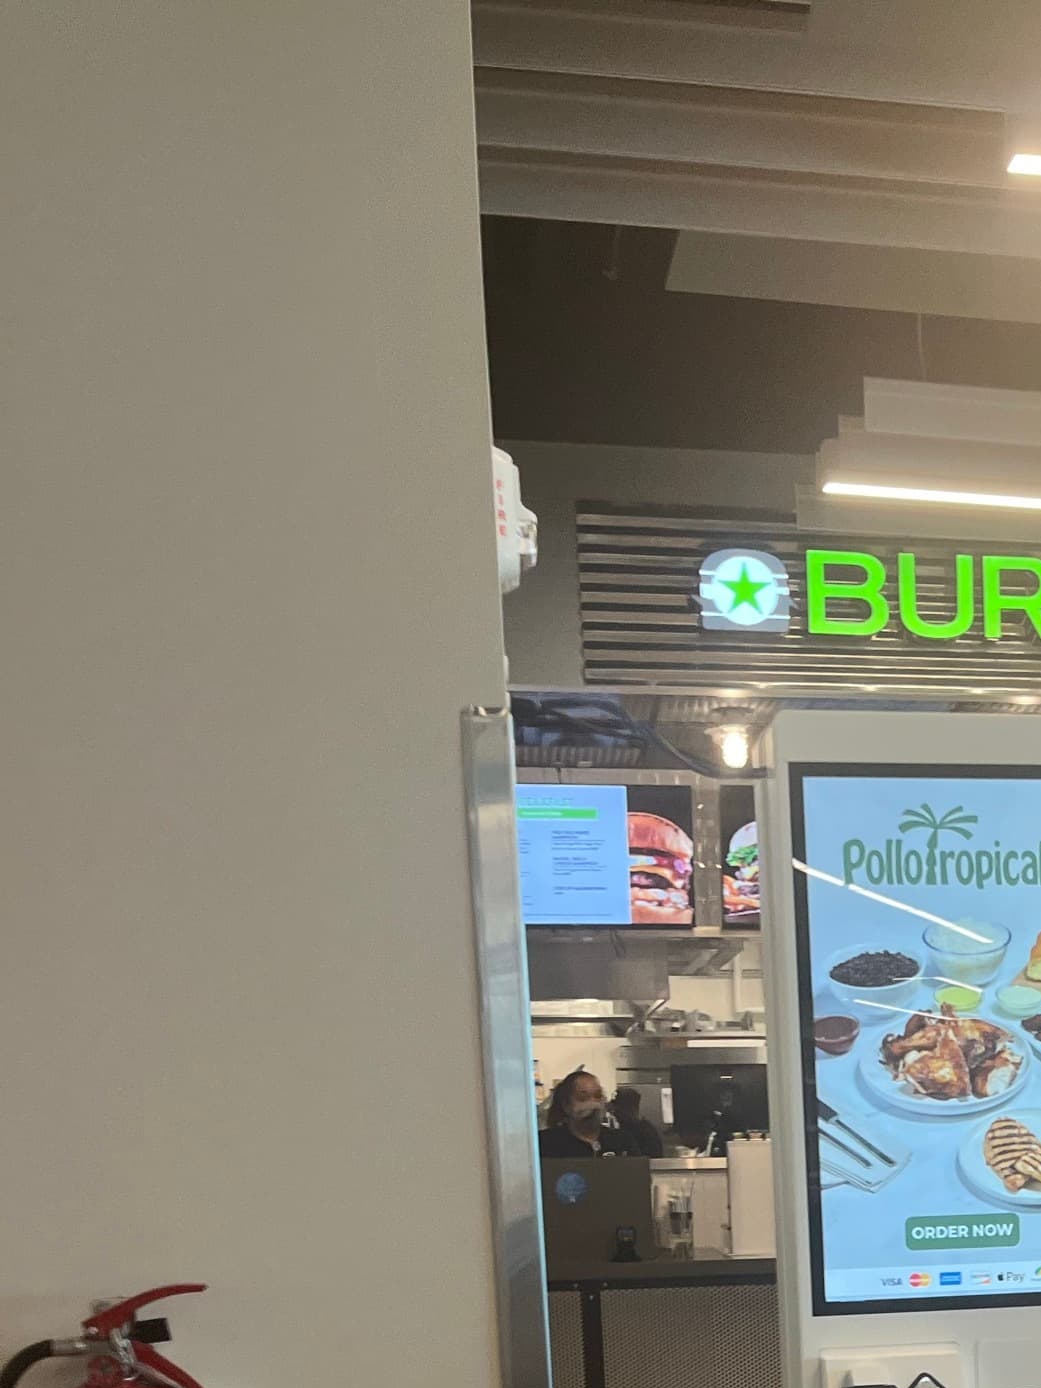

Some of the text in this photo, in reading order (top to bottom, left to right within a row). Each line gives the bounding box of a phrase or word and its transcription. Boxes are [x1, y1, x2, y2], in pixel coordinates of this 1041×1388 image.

[842, 838, 923, 886] Pollo
[911, 1223, 1014, 1240] ORDER NOW
[1006, 1272, 1026, 1283] Pay
